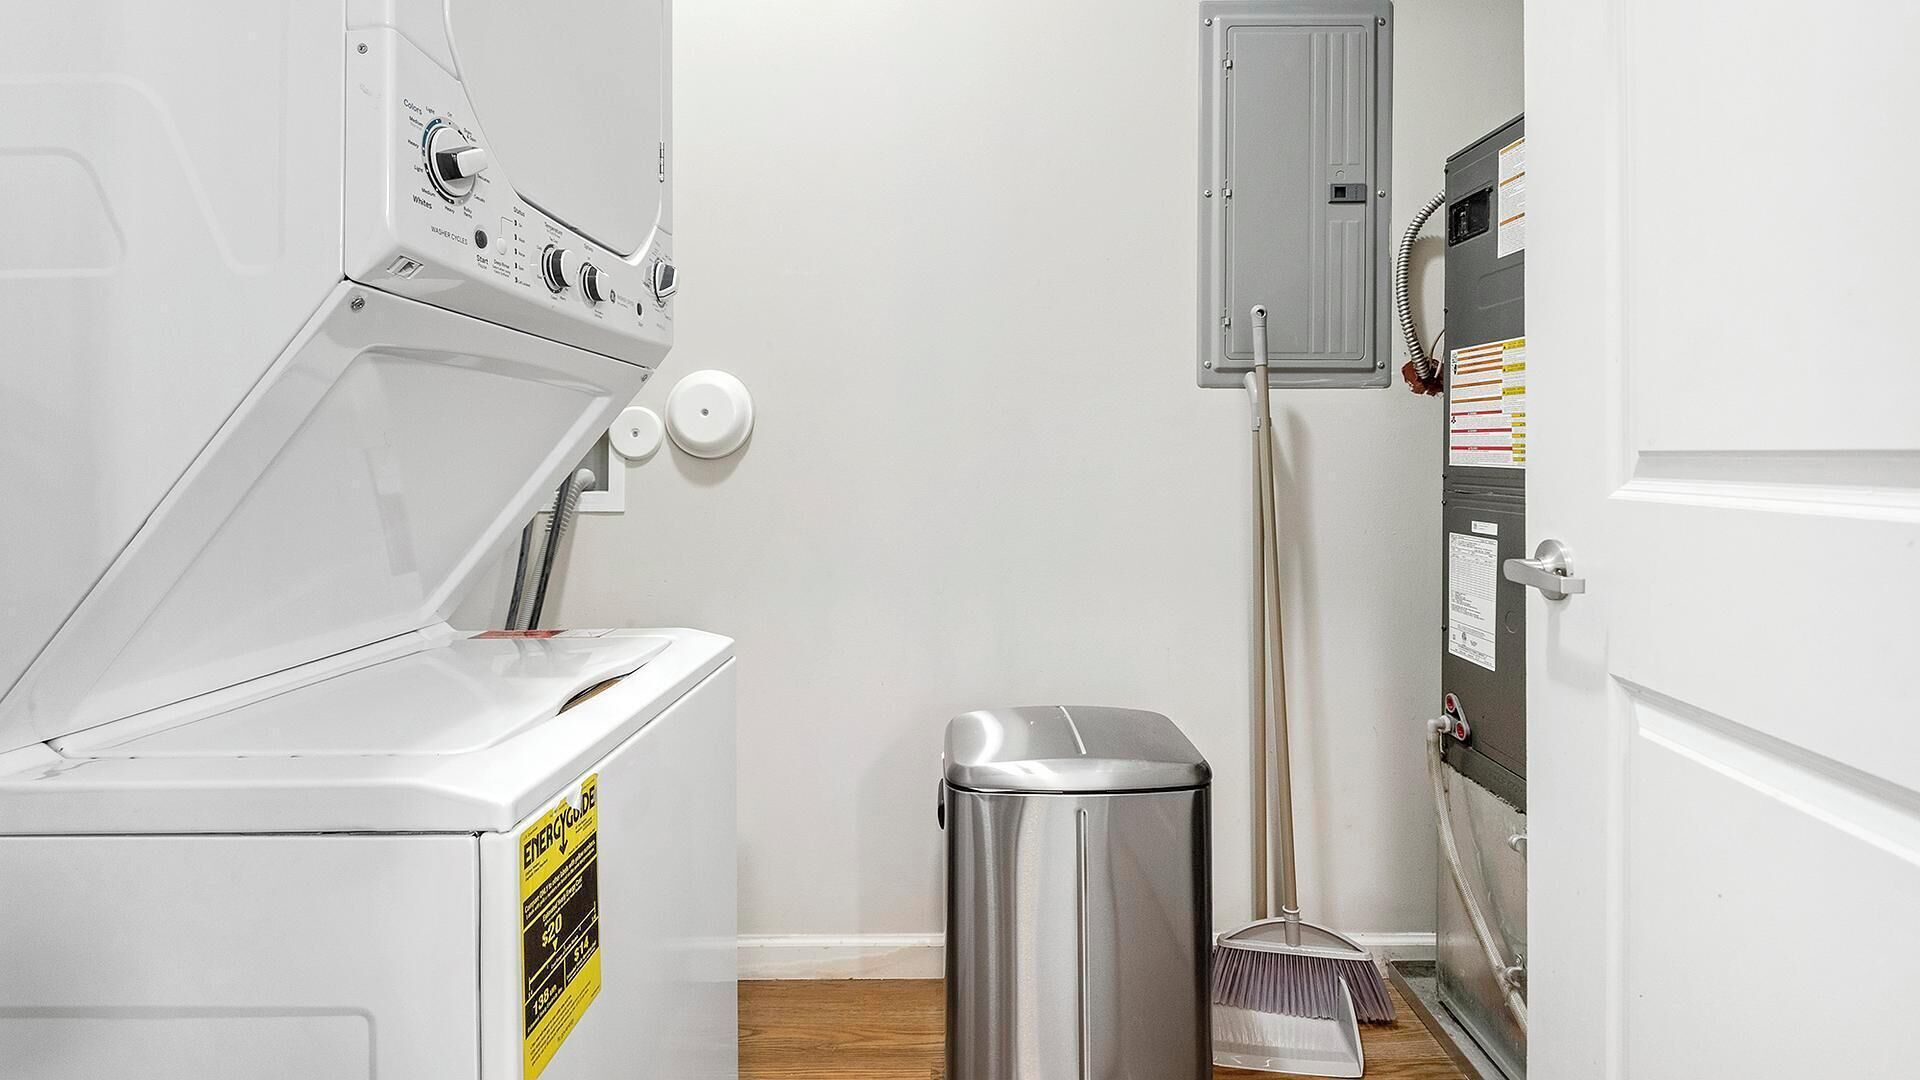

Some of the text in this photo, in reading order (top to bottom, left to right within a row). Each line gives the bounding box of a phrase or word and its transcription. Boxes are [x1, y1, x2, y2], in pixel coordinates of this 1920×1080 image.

[403, 98, 422, 115] Colors
[412, 194, 432, 209] Whites
[431, 226, 450, 238] WASHER
[476, 255, 488, 265] Start
[524, 785, 596, 870] ENERGYGUDE
[542, 913, 562, 947] $20
[574, 935, 589, 962] $14
